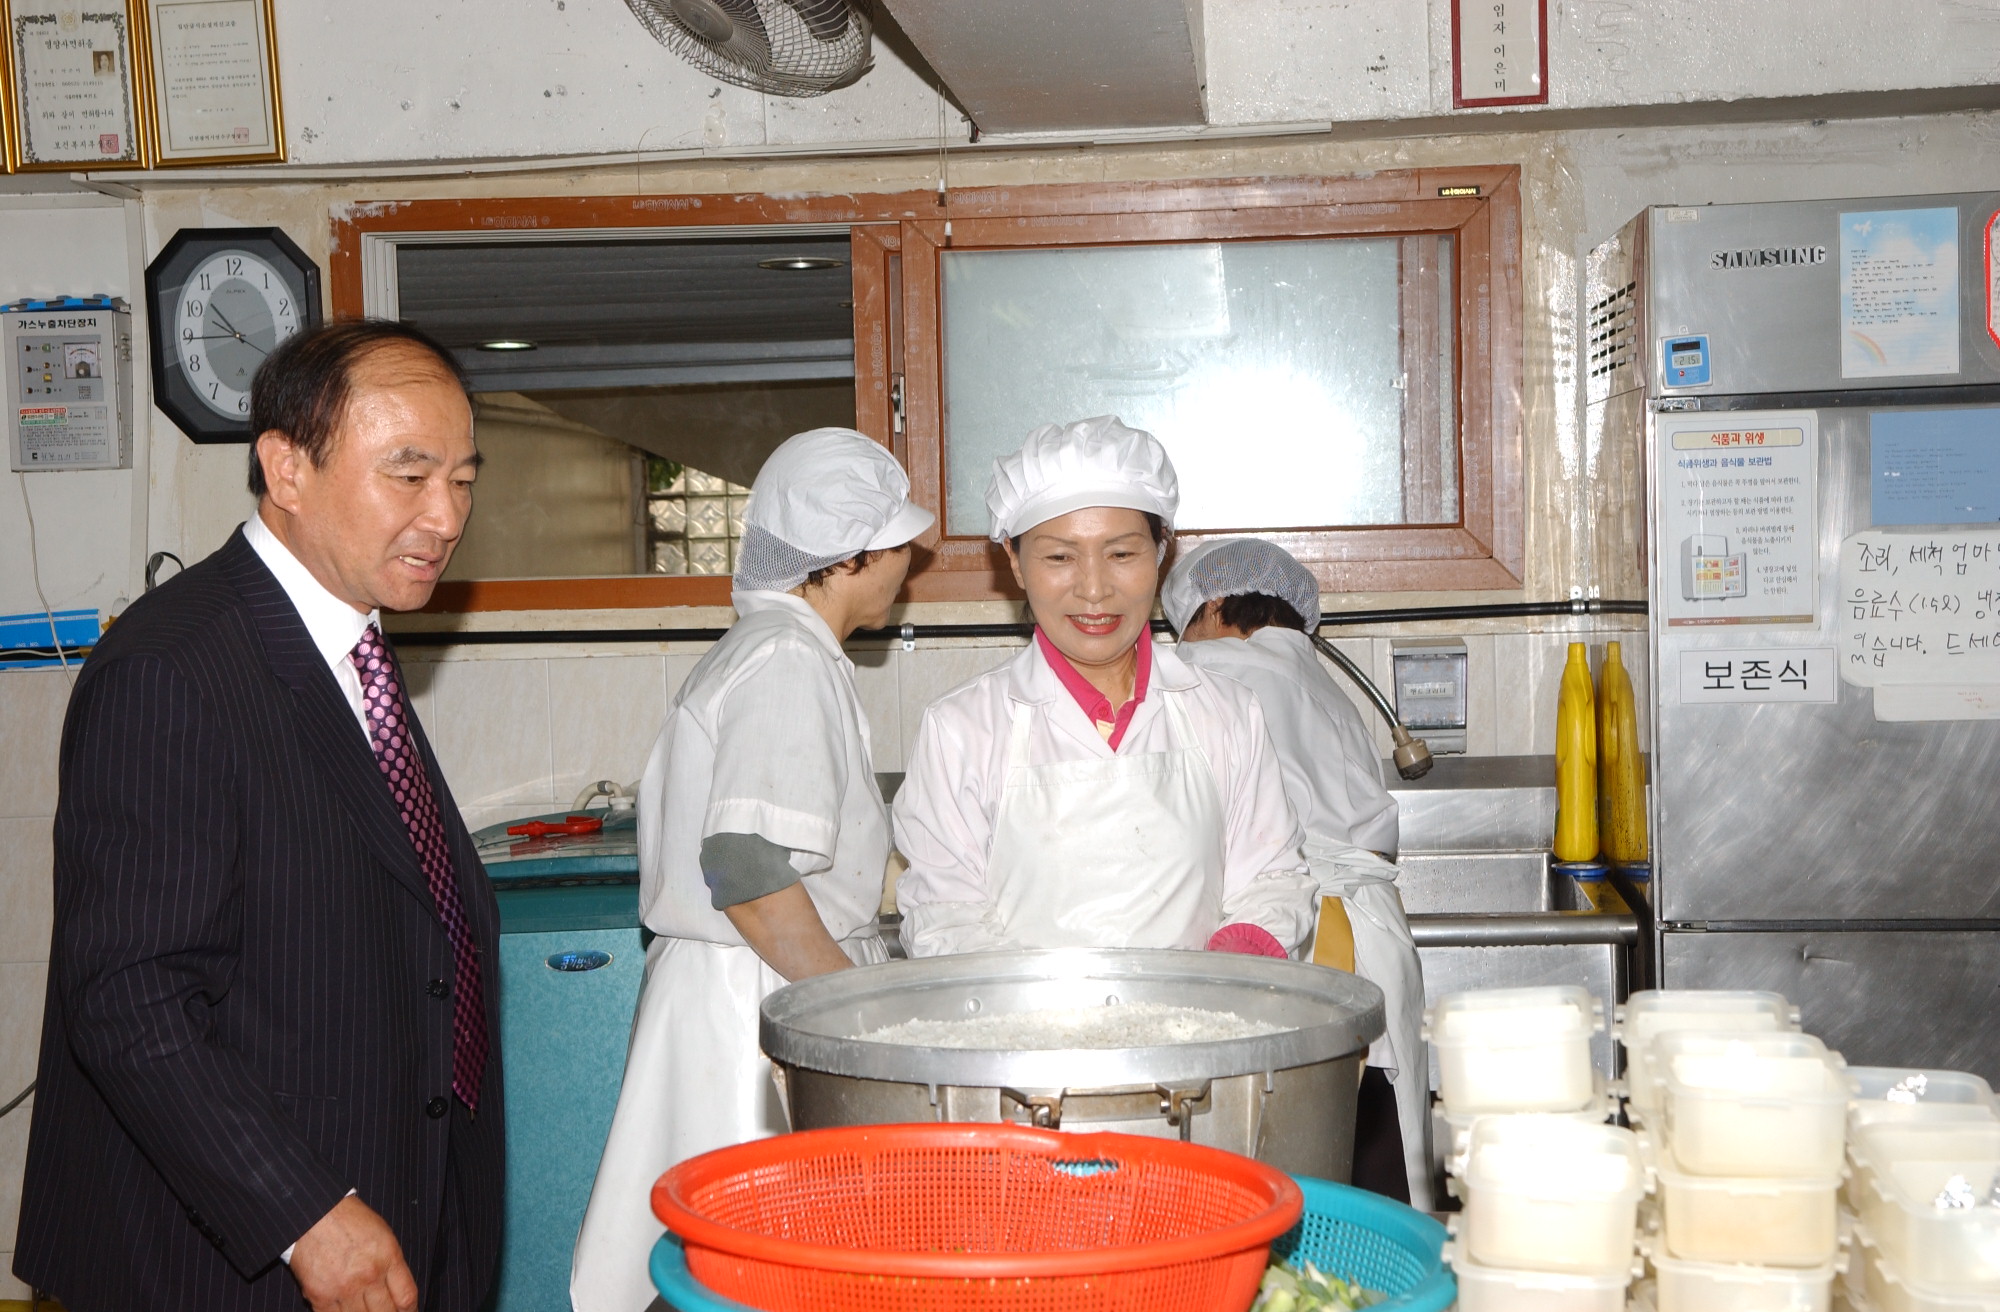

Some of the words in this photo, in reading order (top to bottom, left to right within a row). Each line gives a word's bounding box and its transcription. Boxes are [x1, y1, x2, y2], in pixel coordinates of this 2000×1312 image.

[1493, 44, 1507, 92] 이은미
[226, 257, 243, 276] 12
[1709, 245, 1827, 271] SAMSUNG
[199, 273, 212, 291] 11
[263, 272, 270, 290] 1
[186, 299, 203, 318] 10
[279, 298, 290, 317] 2
[182, 327, 194, 345] 9
[189, 354, 201, 373] 8
[208, 382, 219, 401] 7
[238, 394, 249, 413] 6
[1710, 432, 1741, 446] 식품과
[1744, 431, 1765, 445] 위생
[1677, 458, 1718, 469] 식품위생과
[1721, 457, 1745, 468] 음식물
[1748, 456, 1772, 466] 보관법
[1856, 542, 1899, 577] 조리,
[1909, 540, 1944, 576] 세척
[1850, 631, 1927, 668] 있습니다.
[1701, 658, 1809, 691] 보존식
